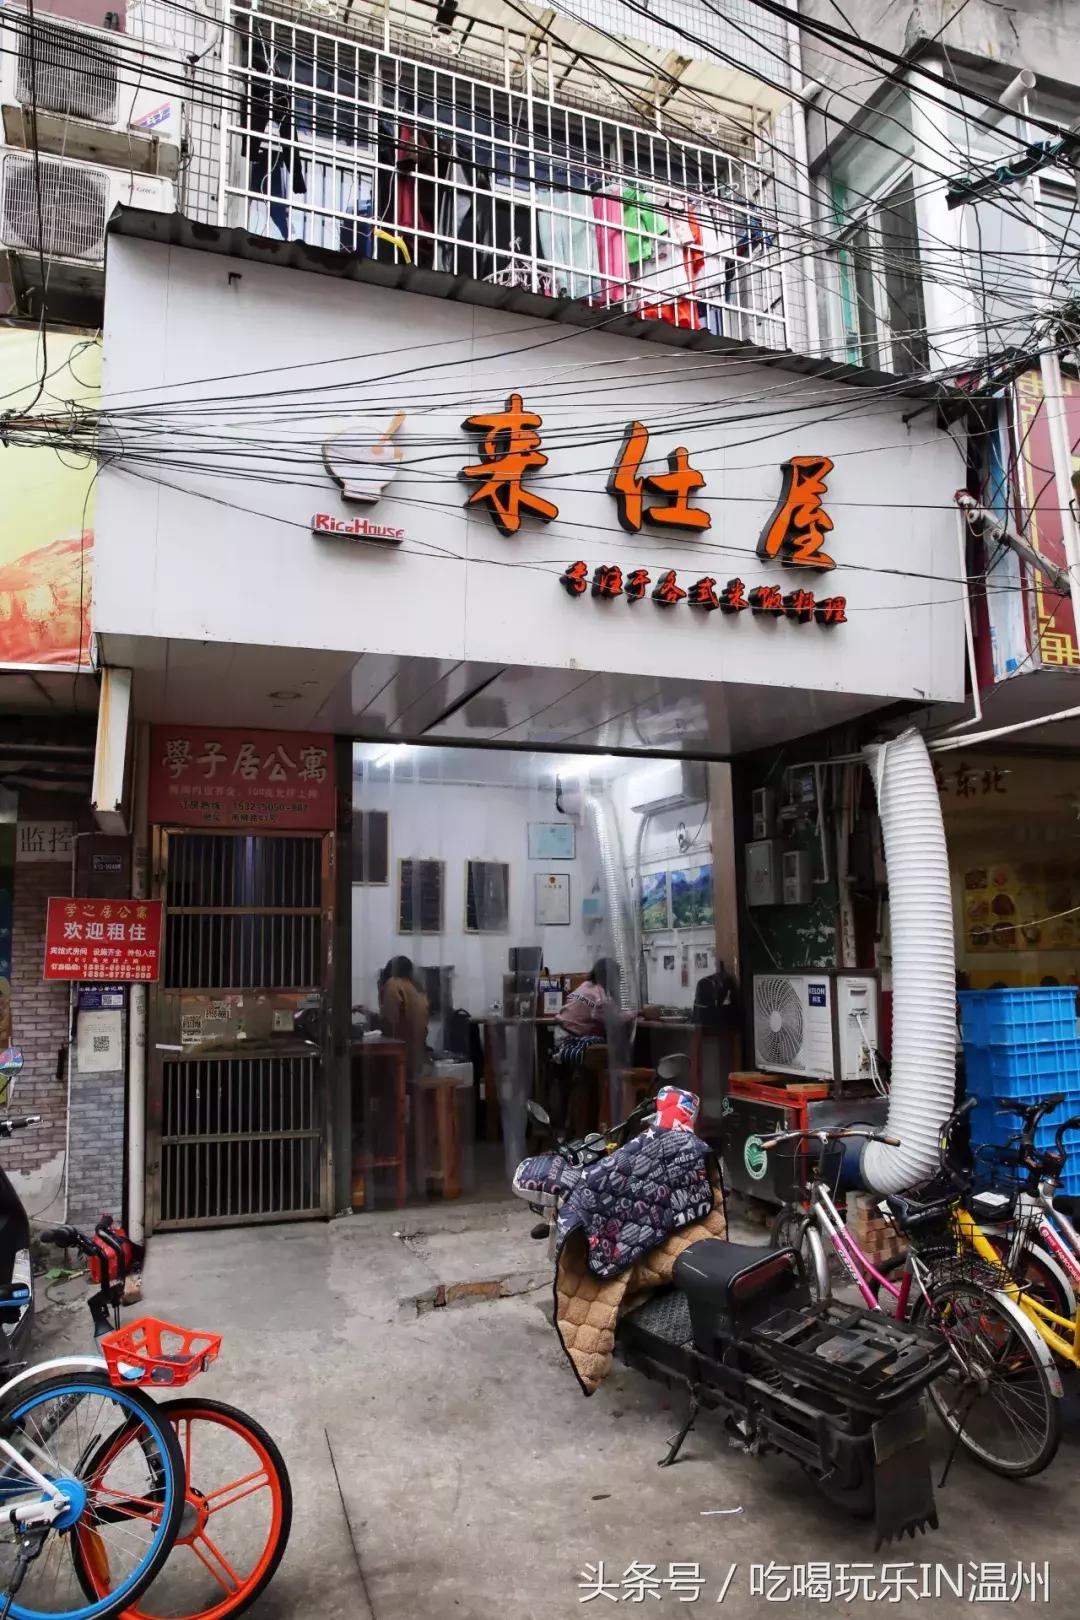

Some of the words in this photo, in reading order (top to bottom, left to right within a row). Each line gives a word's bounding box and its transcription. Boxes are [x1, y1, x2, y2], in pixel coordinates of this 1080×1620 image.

[162, 739, 328, 784] 學子居公寓
[63, 921, 147, 941] 欢迎租住
